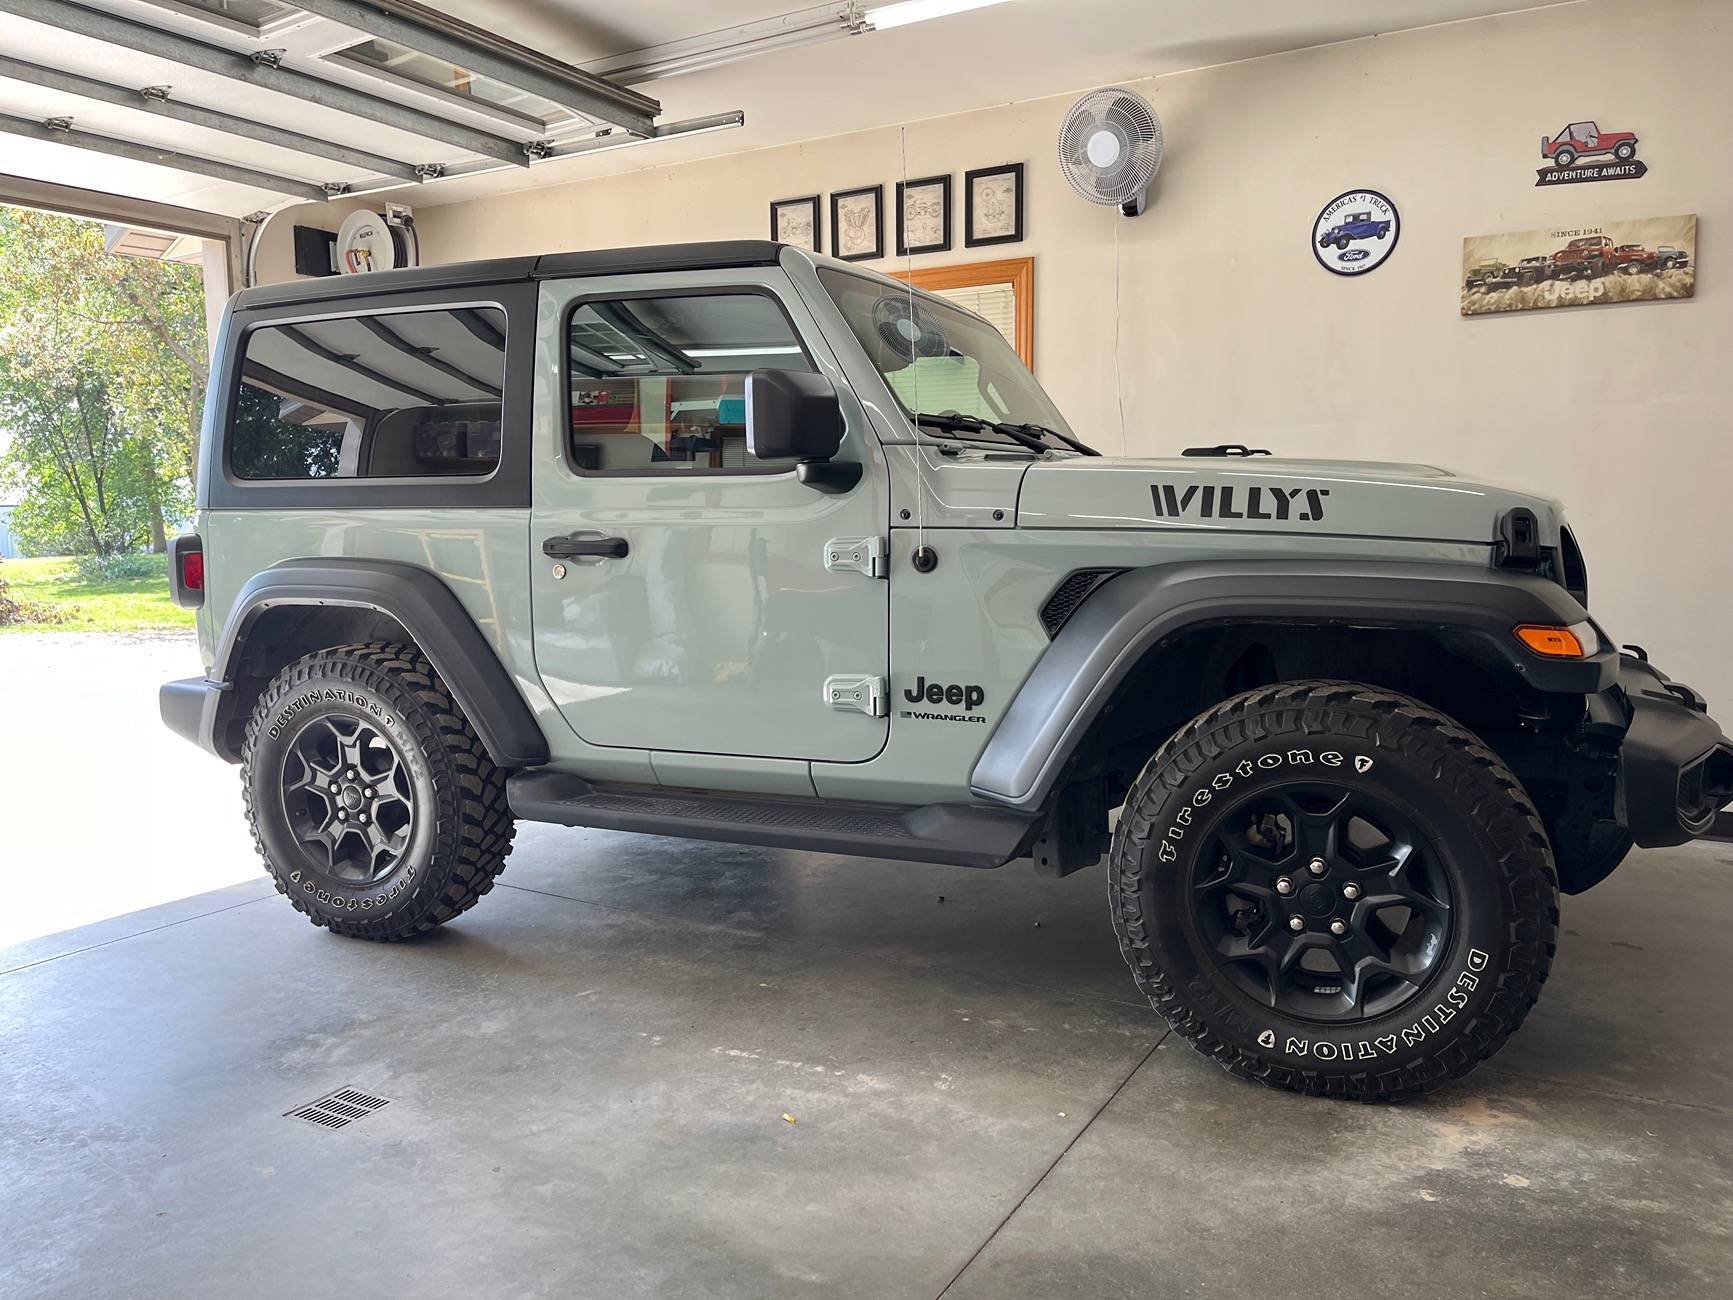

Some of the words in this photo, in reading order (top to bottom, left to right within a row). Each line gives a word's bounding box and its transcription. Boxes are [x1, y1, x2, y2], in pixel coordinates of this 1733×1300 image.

[1545, 168, 1599, 181] ADVENTURE
[1601, 165, 1636, 177] AWAITS
[1369, 196, 1390, 215] TRUCK
[1551, 230, 1580, 238] SINCE
[1583, 228, 1602, 236] 1941
[1343, 251, 1364, 261] Ford
[1544, 280, 1605, 301] Jeep
[1150, 485, 1330, 521] WILLYS
[903, 676, 985, 711] Jeep
[267, 689, 382, 741] DESTINATION
[912, 711, 986, 723] WRANGLER
[1159, 750, 1344, 863] Firestone
[303, 865, 416, 912] Firestone
[1285, 948, 1489, 1061] DESTINATION
